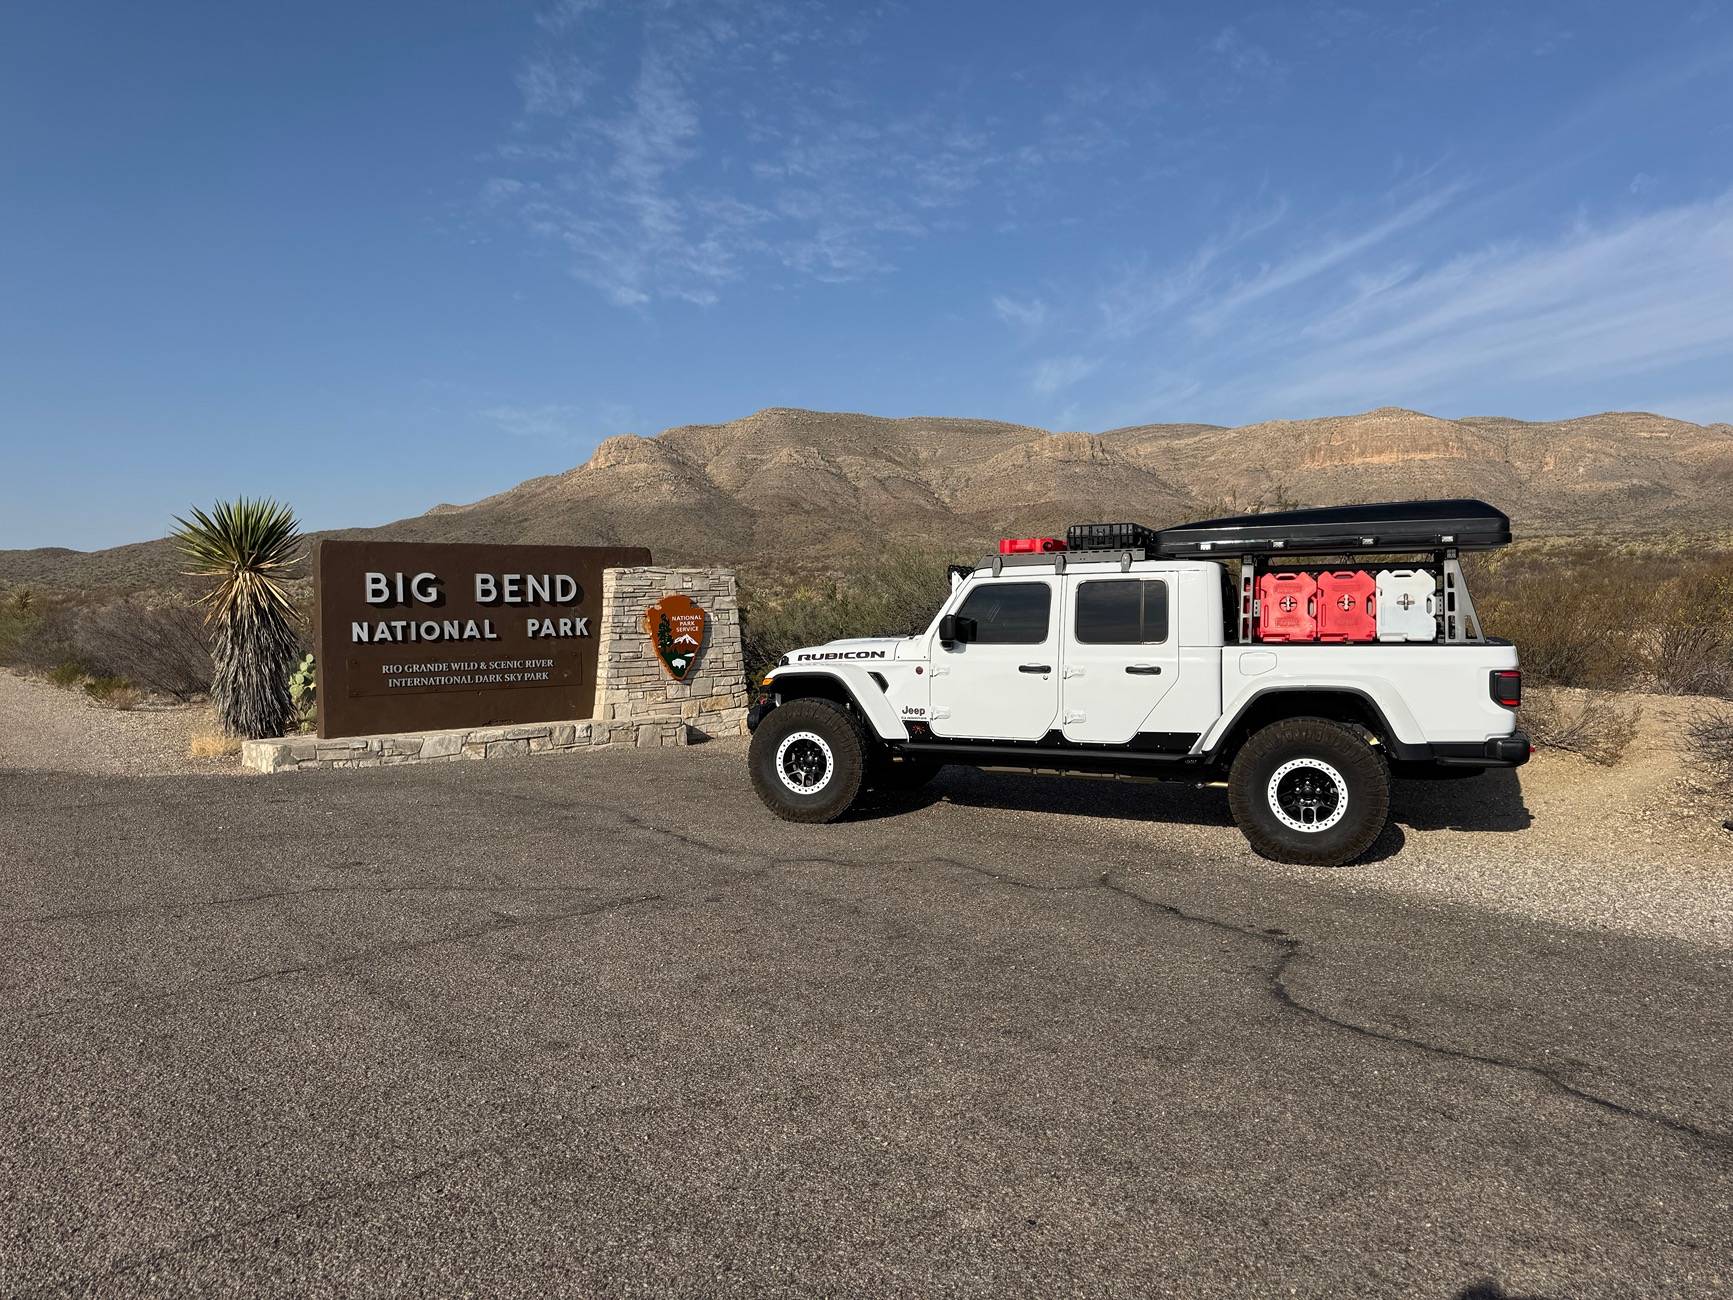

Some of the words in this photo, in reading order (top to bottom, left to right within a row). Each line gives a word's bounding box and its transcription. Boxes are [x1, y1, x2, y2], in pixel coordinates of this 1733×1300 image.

[365, 572, 438, 603] BIG
[475, 573, 577, 603] BEND
[352, 619, 497, 642] NATIONAL
[527, 617, 589, 637] PARK
[797, 650, 886, 661] RUBICON
[382, 664, 403, 674] RIO
[404, 662, 449, 673] GRANDE
[451, 661, 478, 671] WILD
[480, 661, 488, 670] &
[489, 660, 524, 670] SCENIC
[525, 659, 554, 668] RIVER
[388, 675, 474, 687] INTERNATIONAL
[475, 673, 502, 683] DARK
[504, 672, 523, 682] SKY
[524, 671, 549, 681] PARK
[902, 705, 926, 716] Jeep
